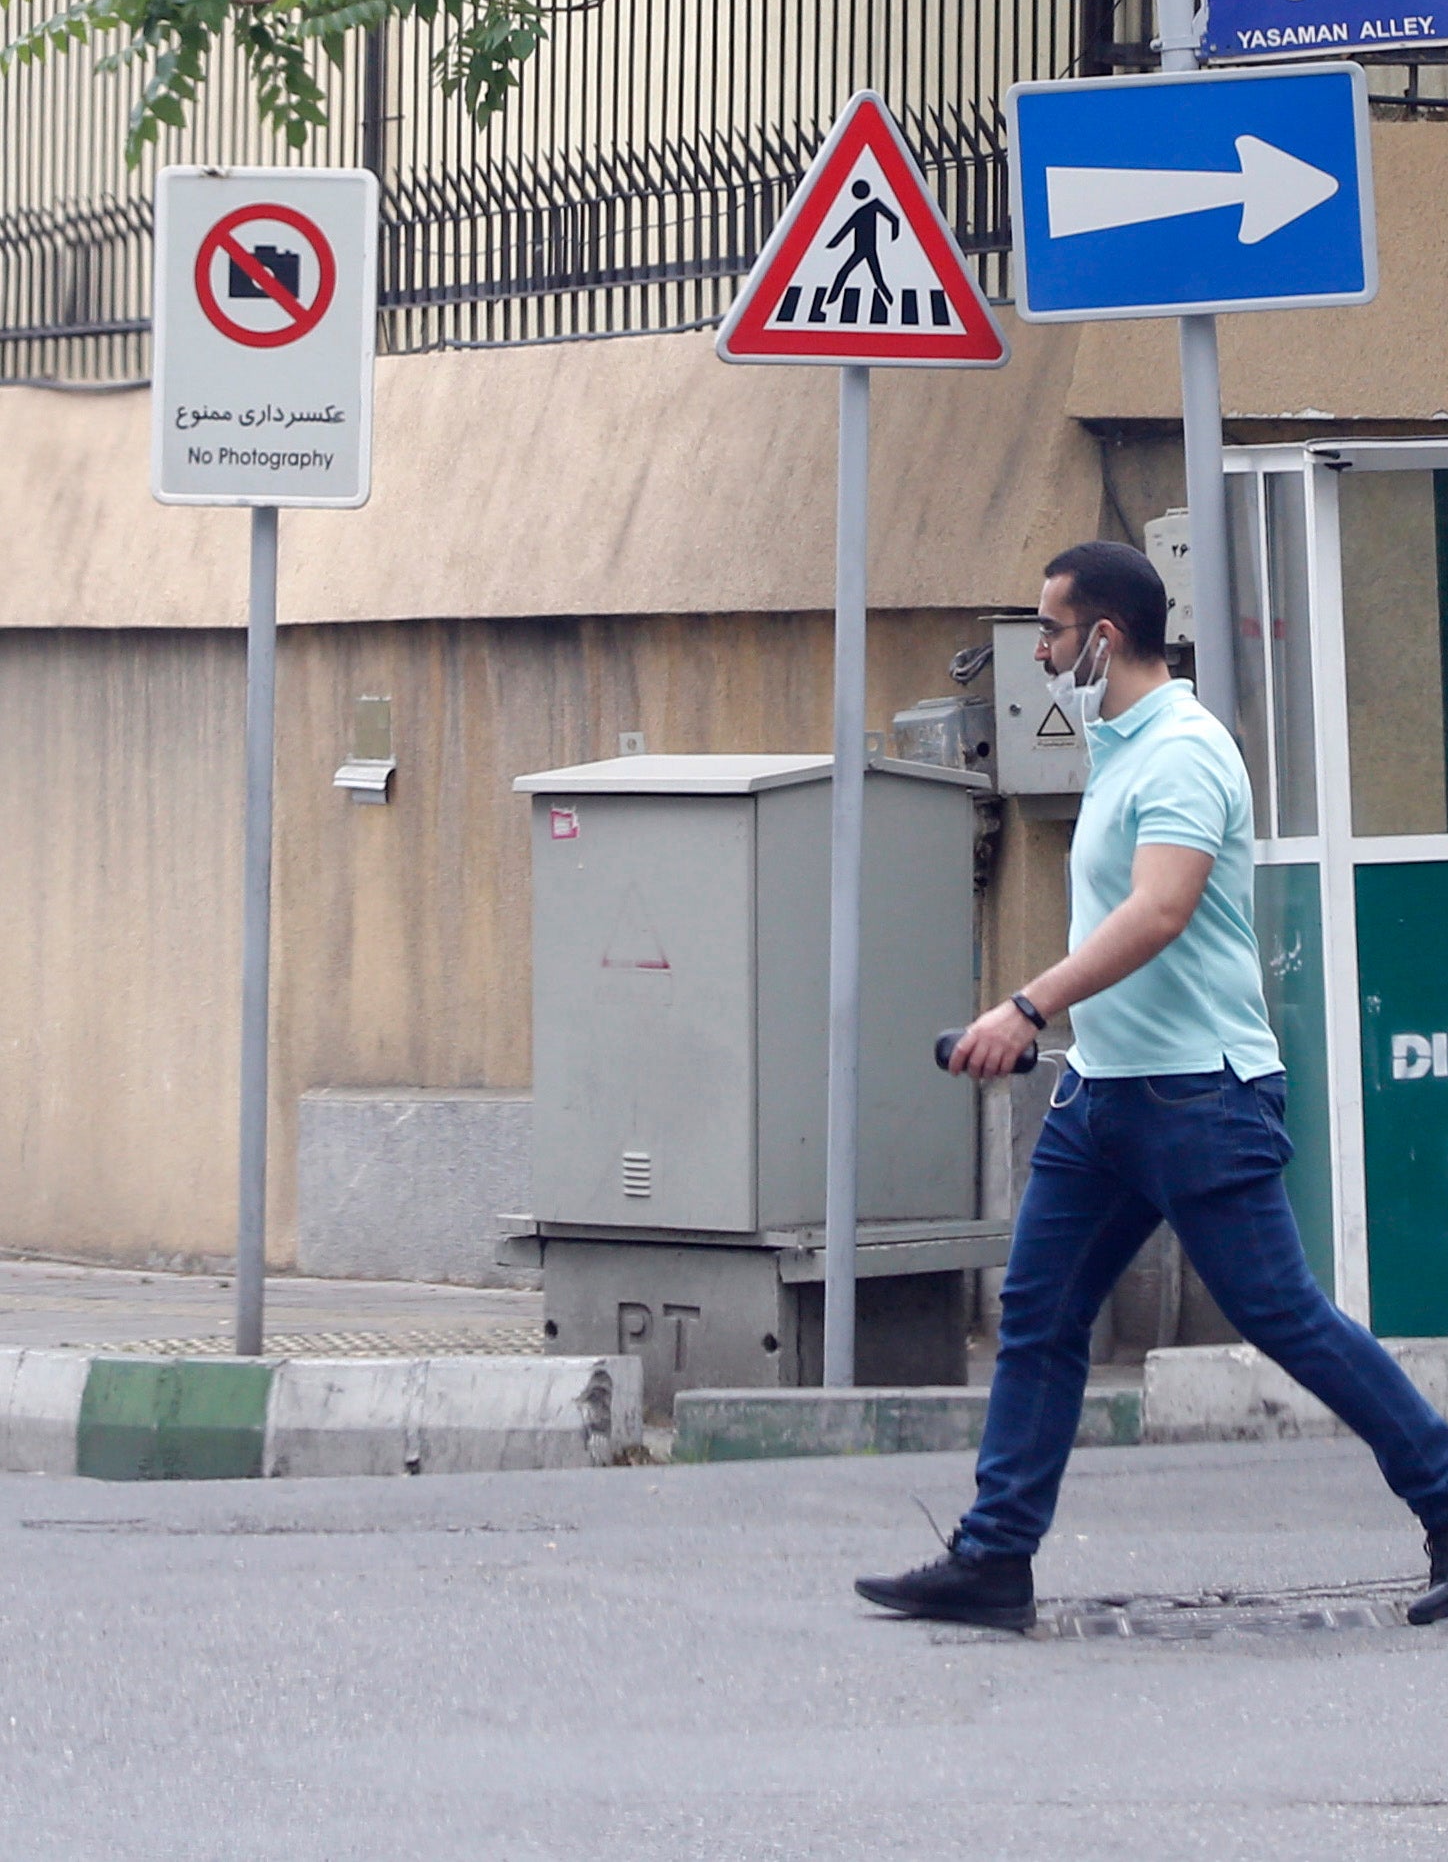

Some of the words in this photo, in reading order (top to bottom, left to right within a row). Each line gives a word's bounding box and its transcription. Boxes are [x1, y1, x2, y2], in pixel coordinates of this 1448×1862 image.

[1237, 23, 1348, 49] YASAMAN
[176, 405, 233, 430] ممنوع
[188, 447, 213, 465] No
[219, 447, 335, 470] Photography
[618, 1302, 700, 1372] PT
